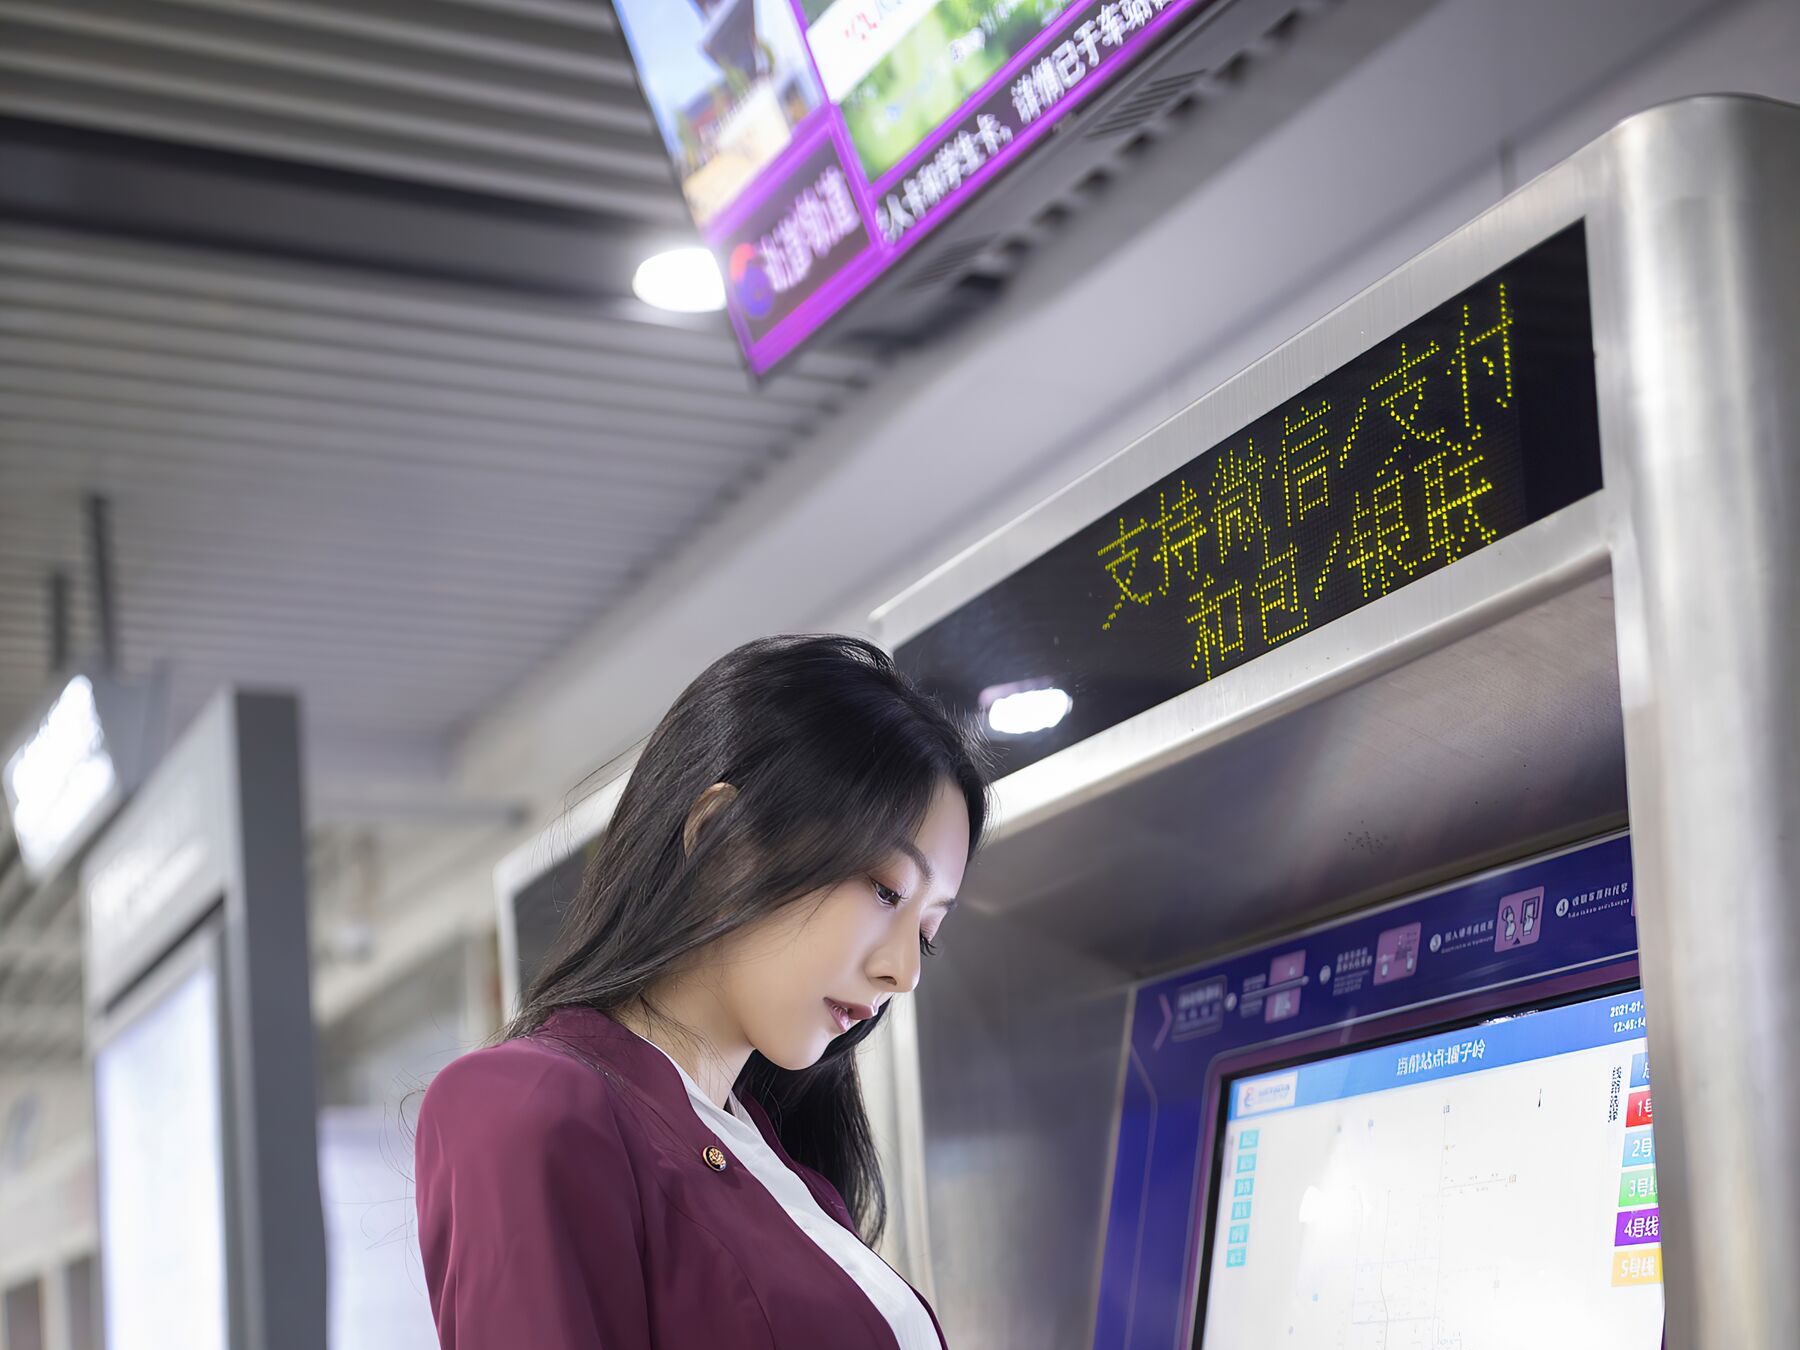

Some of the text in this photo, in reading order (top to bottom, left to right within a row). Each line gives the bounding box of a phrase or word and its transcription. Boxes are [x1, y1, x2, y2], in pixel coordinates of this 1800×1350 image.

[1098, 283, 1513, 630] 支持微信/支付
[1186, 425, 1497, 681] 和包/银联
[1620, 1255, 1656, 1279] 5号线
[1623, 1215, 1660, 1238] 4号线
